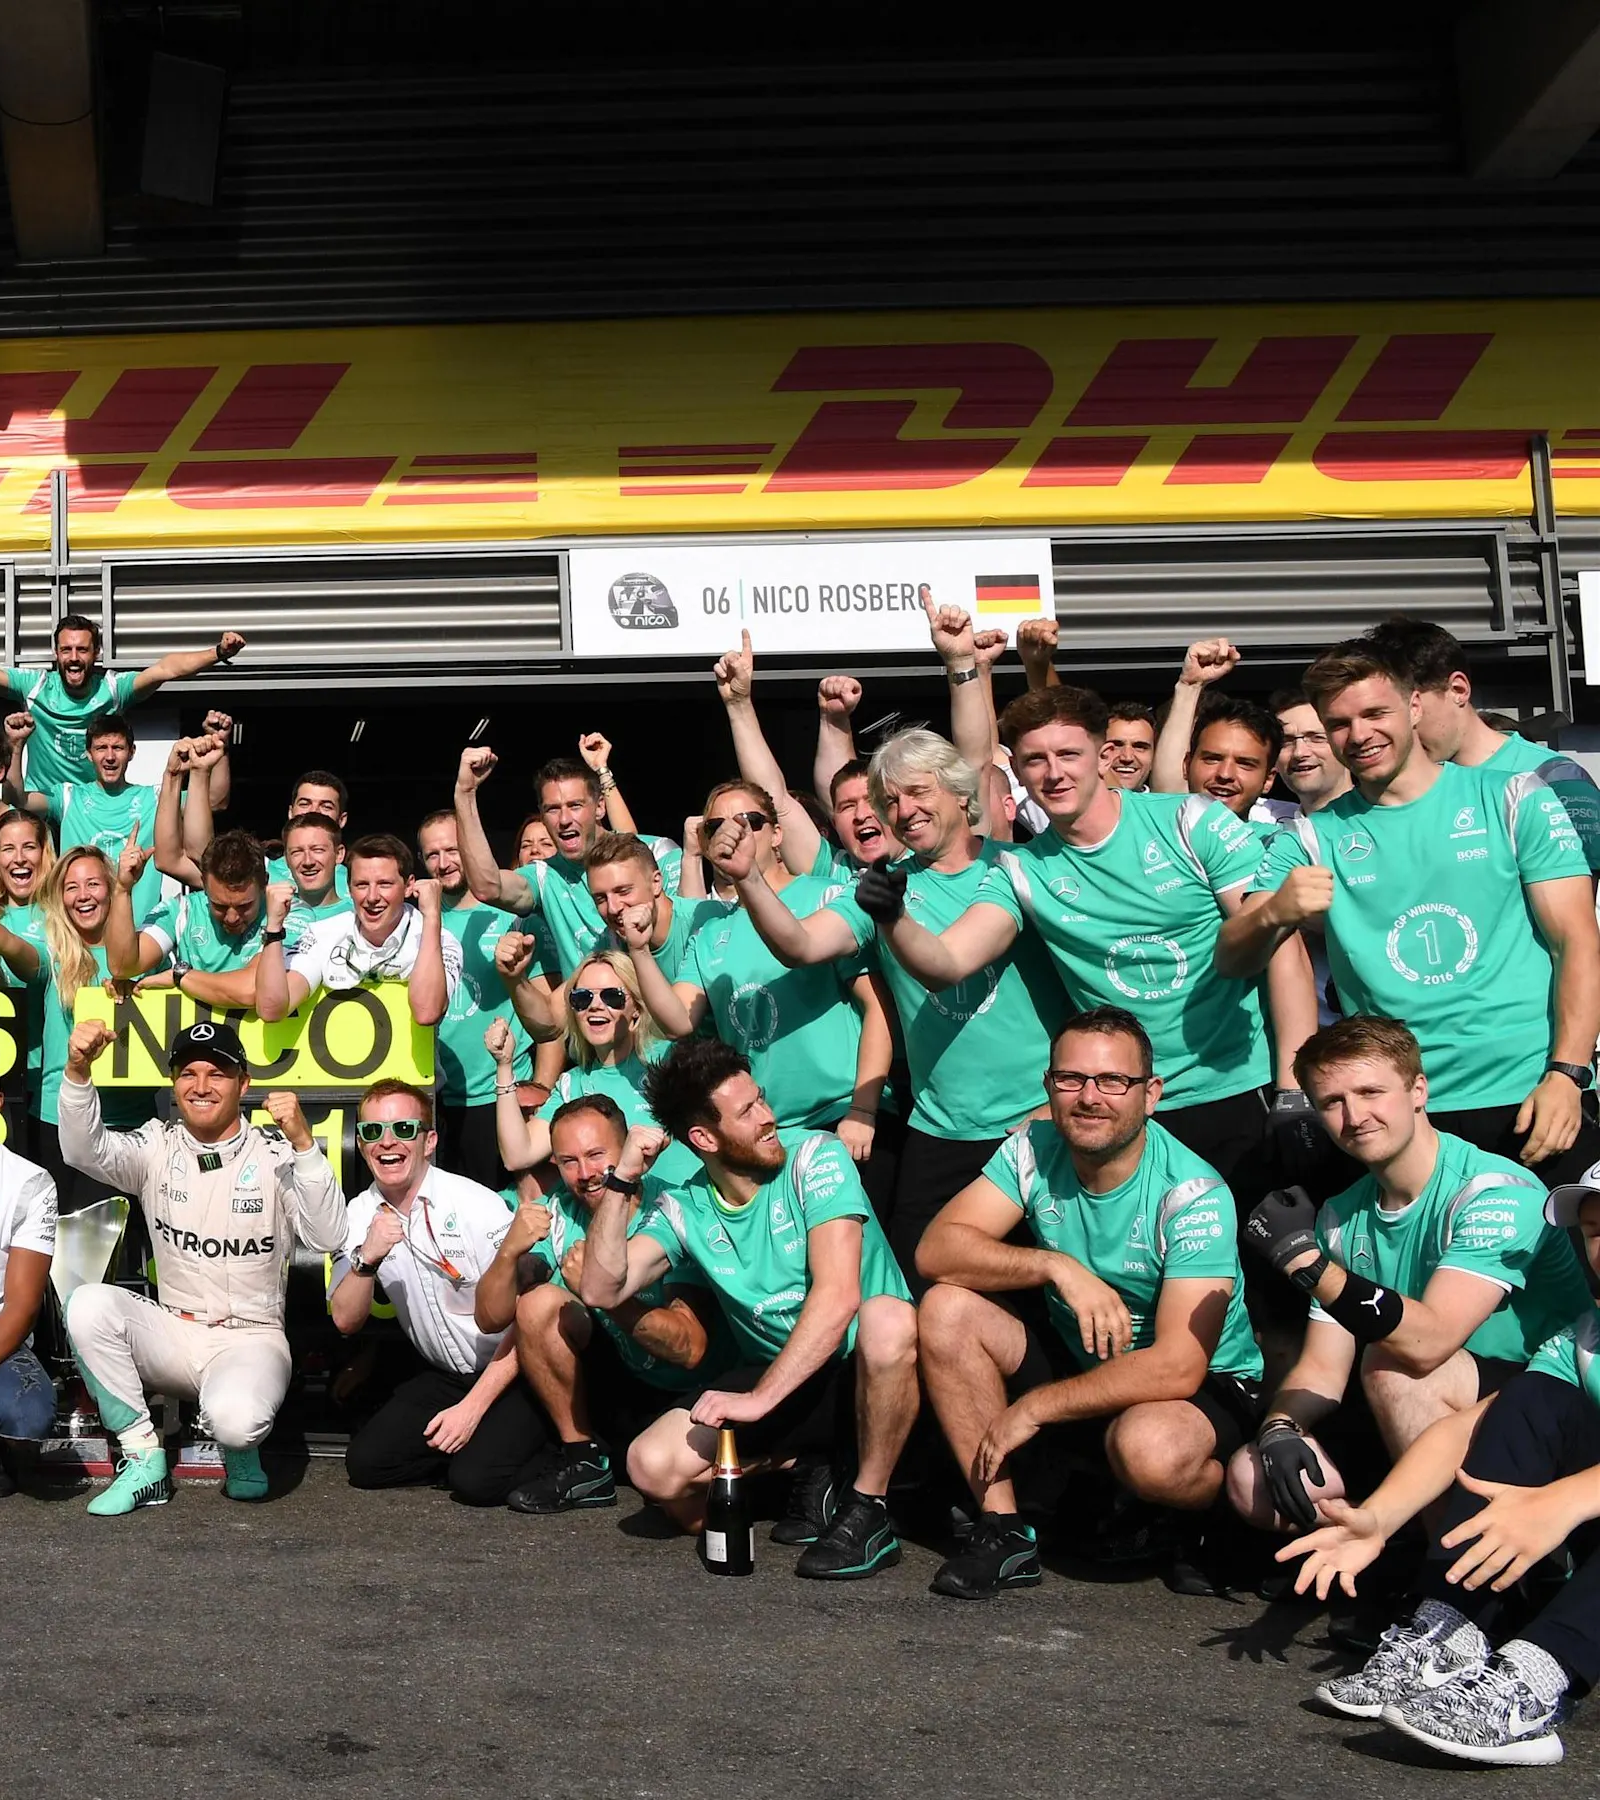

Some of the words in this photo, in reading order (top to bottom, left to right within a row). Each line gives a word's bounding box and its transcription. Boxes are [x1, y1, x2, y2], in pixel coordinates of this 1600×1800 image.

[761, 333, 1548, 493] DHL
[703, 587, 730, 615] 06
[753, 585, 809, 614] NICO
[1457, 848, 1488, 860] BOSS
[1155, 877, 1182, 893] BOSS
[1357, 873, 1376, 884] UBS
[1070, 914, 1088, 923] UBS
[1394, 914, 1408, 930] GP
[1407, 903, 1458, 919] WINNERS
[1117, 934, 1165, 953] WINNERS
[1416, 920, 1442, 965] 1
[1423, 972, 1454, 985] 2016
[1144, 988, 1171, 1000] 2016
[951, 1011, 974, 1021] 2016
[169, 1188, 188, 1203] UBS
[233, 1200, 263, 1209] BOSS
[1174, 1210, 1219, 1231] EPSON
[1464, 1211, 1515, 1224] EPSON
[155, 1217, 275, 1258] PETRONAS
[1179, 1240, 1211, 1251] IWC
[753, 1301, 764, 1315] GP
[762, 1291, 805, 1308] WINNERS
